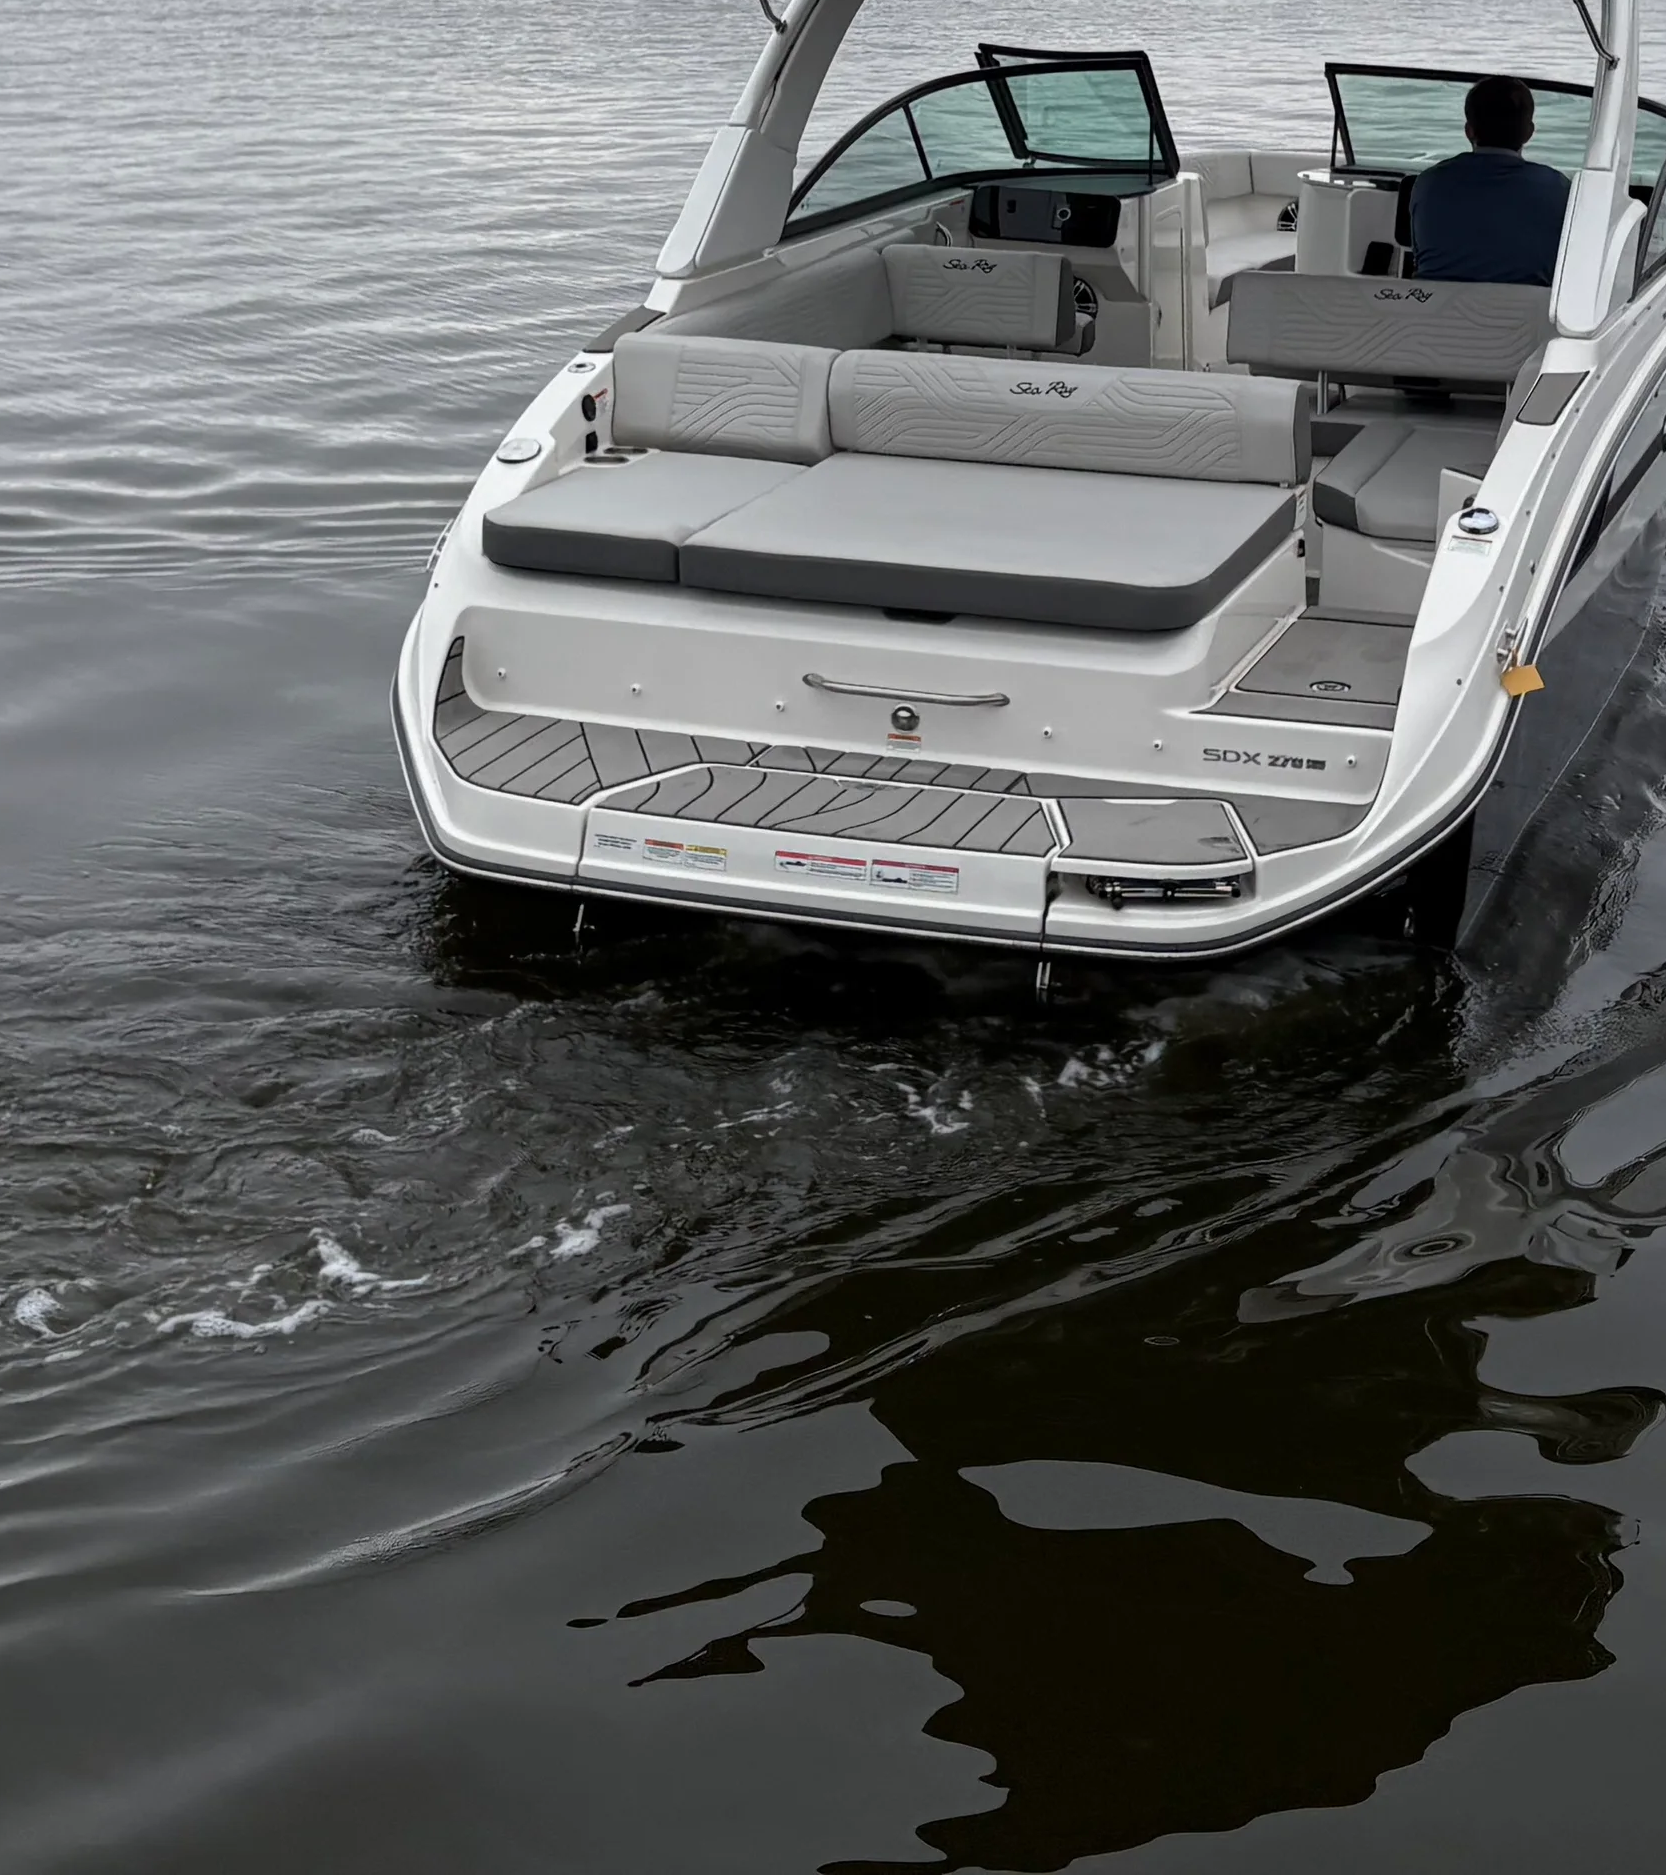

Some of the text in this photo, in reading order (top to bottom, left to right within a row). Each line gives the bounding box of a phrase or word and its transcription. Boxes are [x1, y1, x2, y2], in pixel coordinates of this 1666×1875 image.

[1374, 289, 1402, 300] Sea
[1009, 381, 1078, 398] Sea Ray
[1203, 748, 1261, 766] SDX
